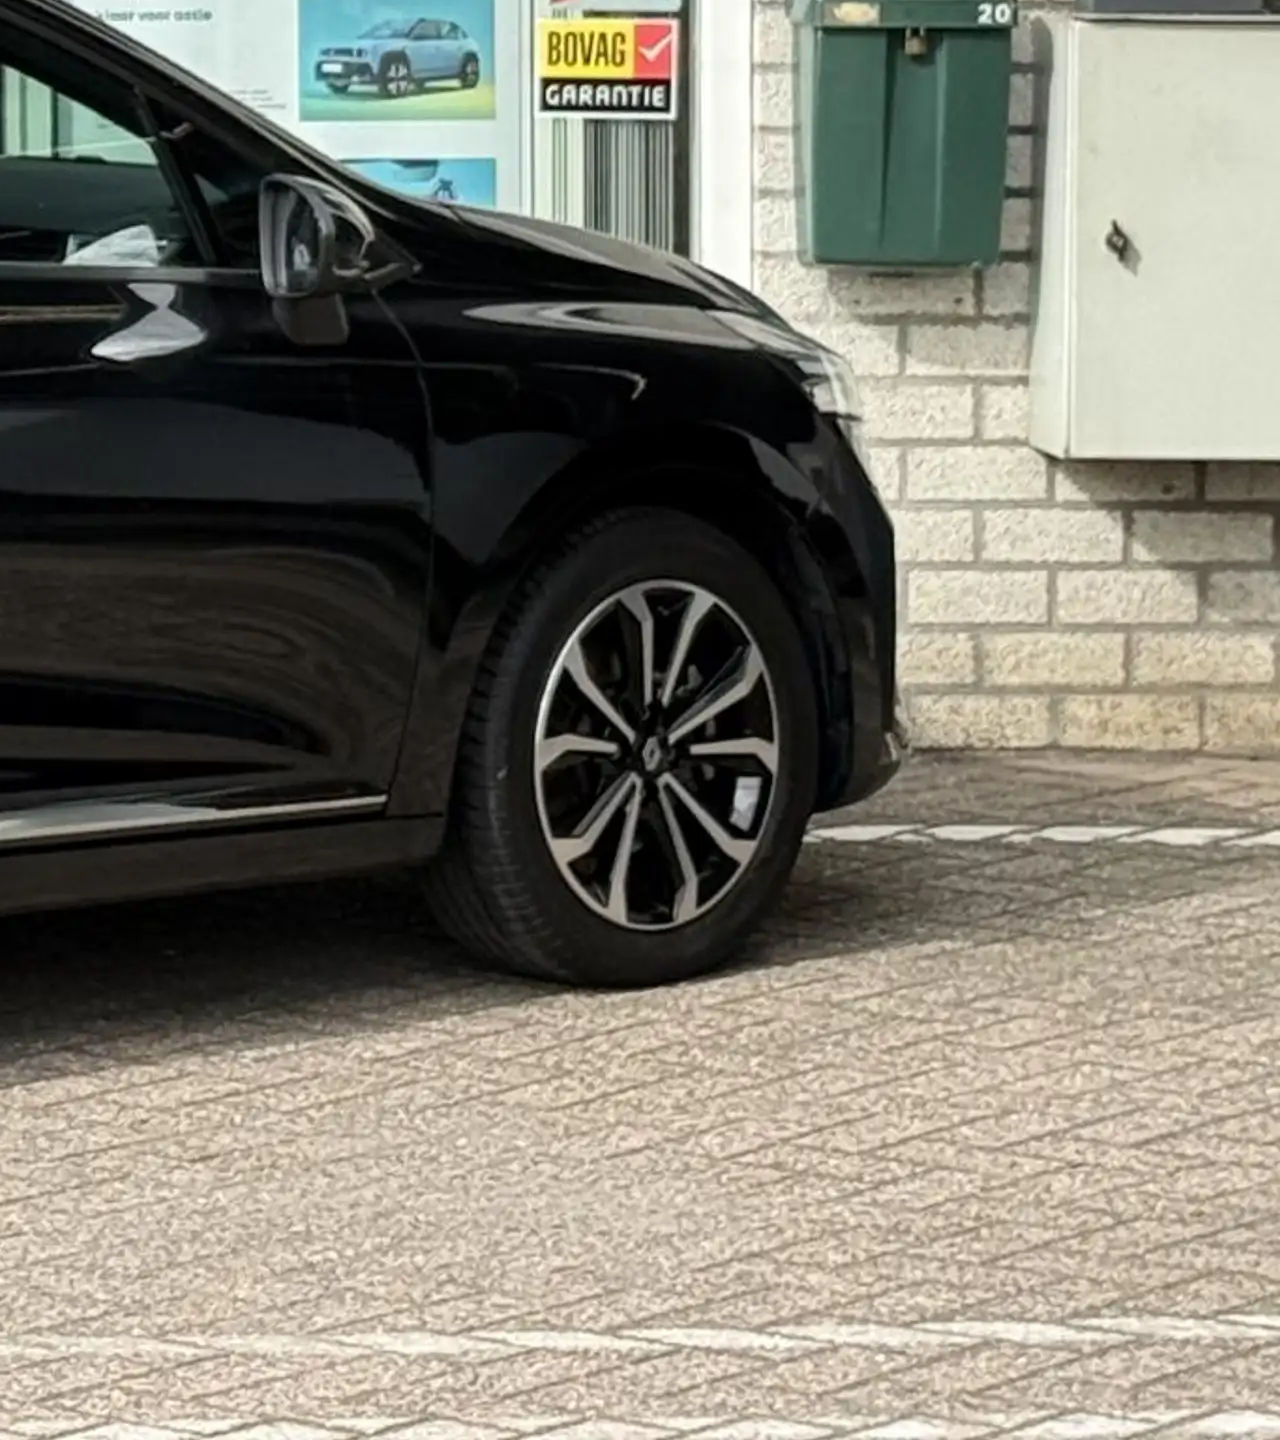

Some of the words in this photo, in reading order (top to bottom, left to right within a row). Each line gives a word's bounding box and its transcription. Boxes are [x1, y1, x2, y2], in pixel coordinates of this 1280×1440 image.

[977, 1, 1011, 25] 20
[547, 31, 626, 67] BOVAG
[545, 83, 666, 107] GARANTIE
